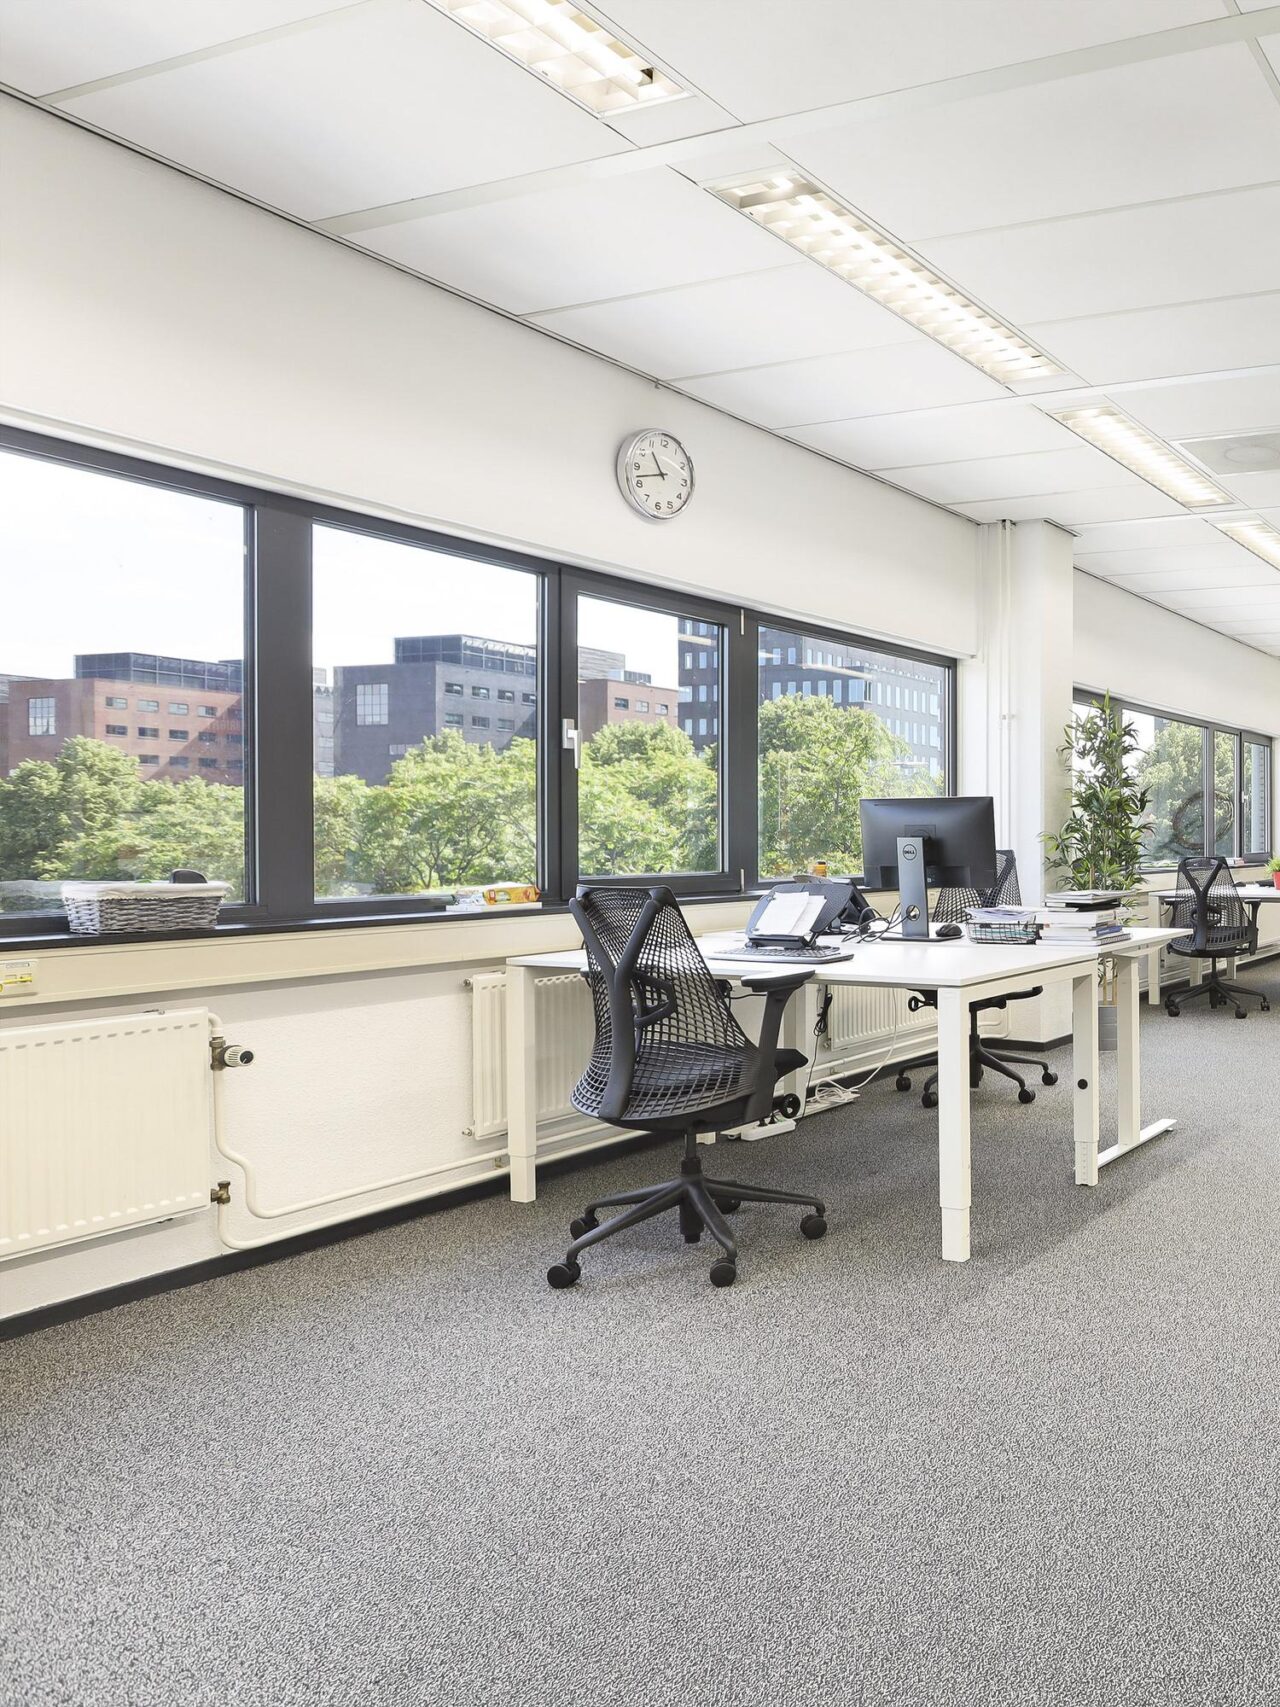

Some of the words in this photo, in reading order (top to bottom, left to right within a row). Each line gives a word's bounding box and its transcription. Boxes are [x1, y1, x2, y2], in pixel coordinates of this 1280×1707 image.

[648, 440, 655, 449] 11
[660, 439, 669, 448] 12
[633, 462, 641, 471] 9
[680, 462, 686, 471] 2
[635, 479, 643, 489] 8
[680, 478, 688, 487] 3
[643, 494, 650, 502] 7
[676, 492, 682, 500] 4
[654, 502, 662, 511] 6
[666, 501, 674, 509] 5
